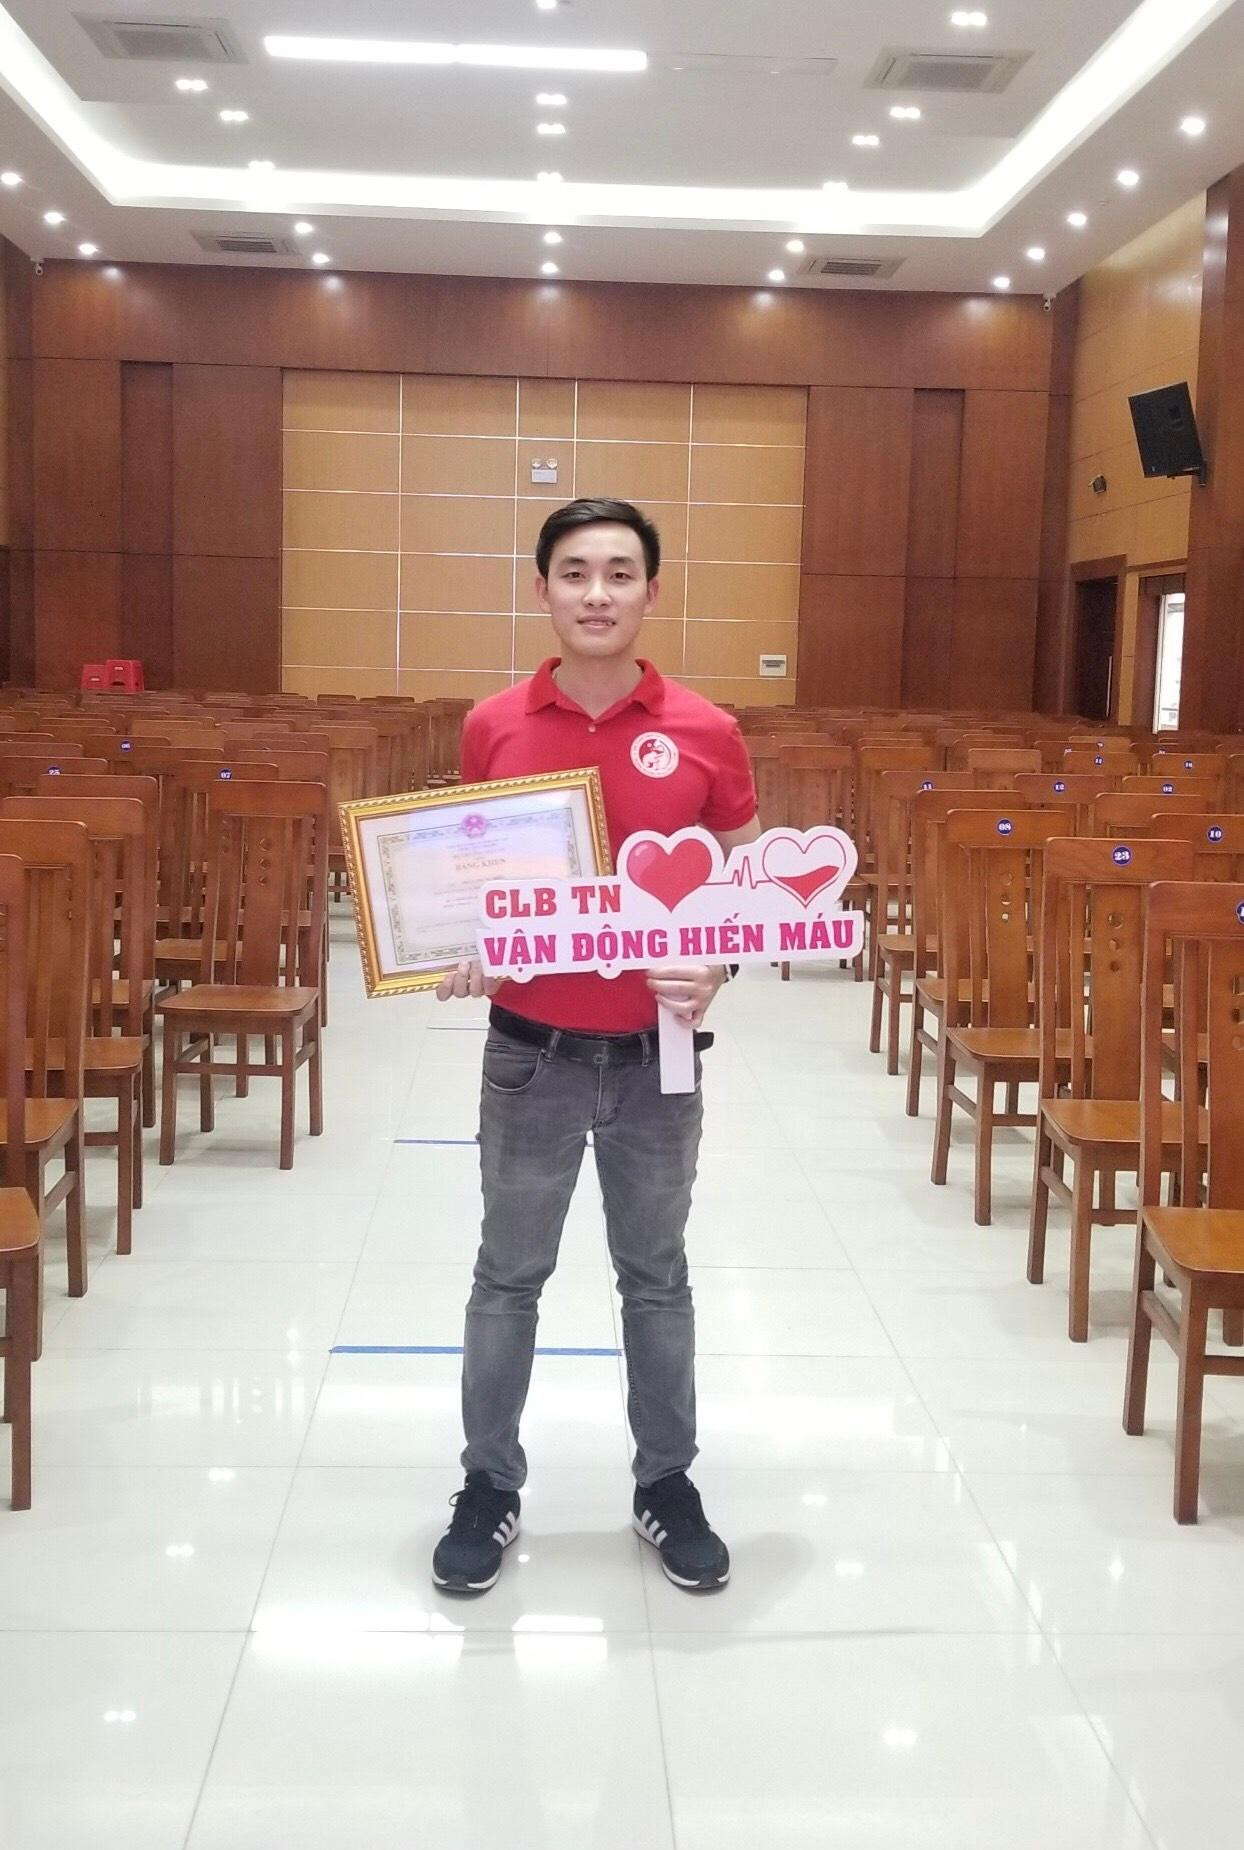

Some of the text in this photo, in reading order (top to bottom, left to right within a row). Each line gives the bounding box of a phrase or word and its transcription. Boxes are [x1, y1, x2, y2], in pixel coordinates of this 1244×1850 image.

[1209, 830, 1222, 838] 10
[1114, 851, 1130, 860] 23
[486, 883, 622, 918] CLB TN
[484, 912, 855, 973] VẬN ĐỘNG HIẾN MÁU
